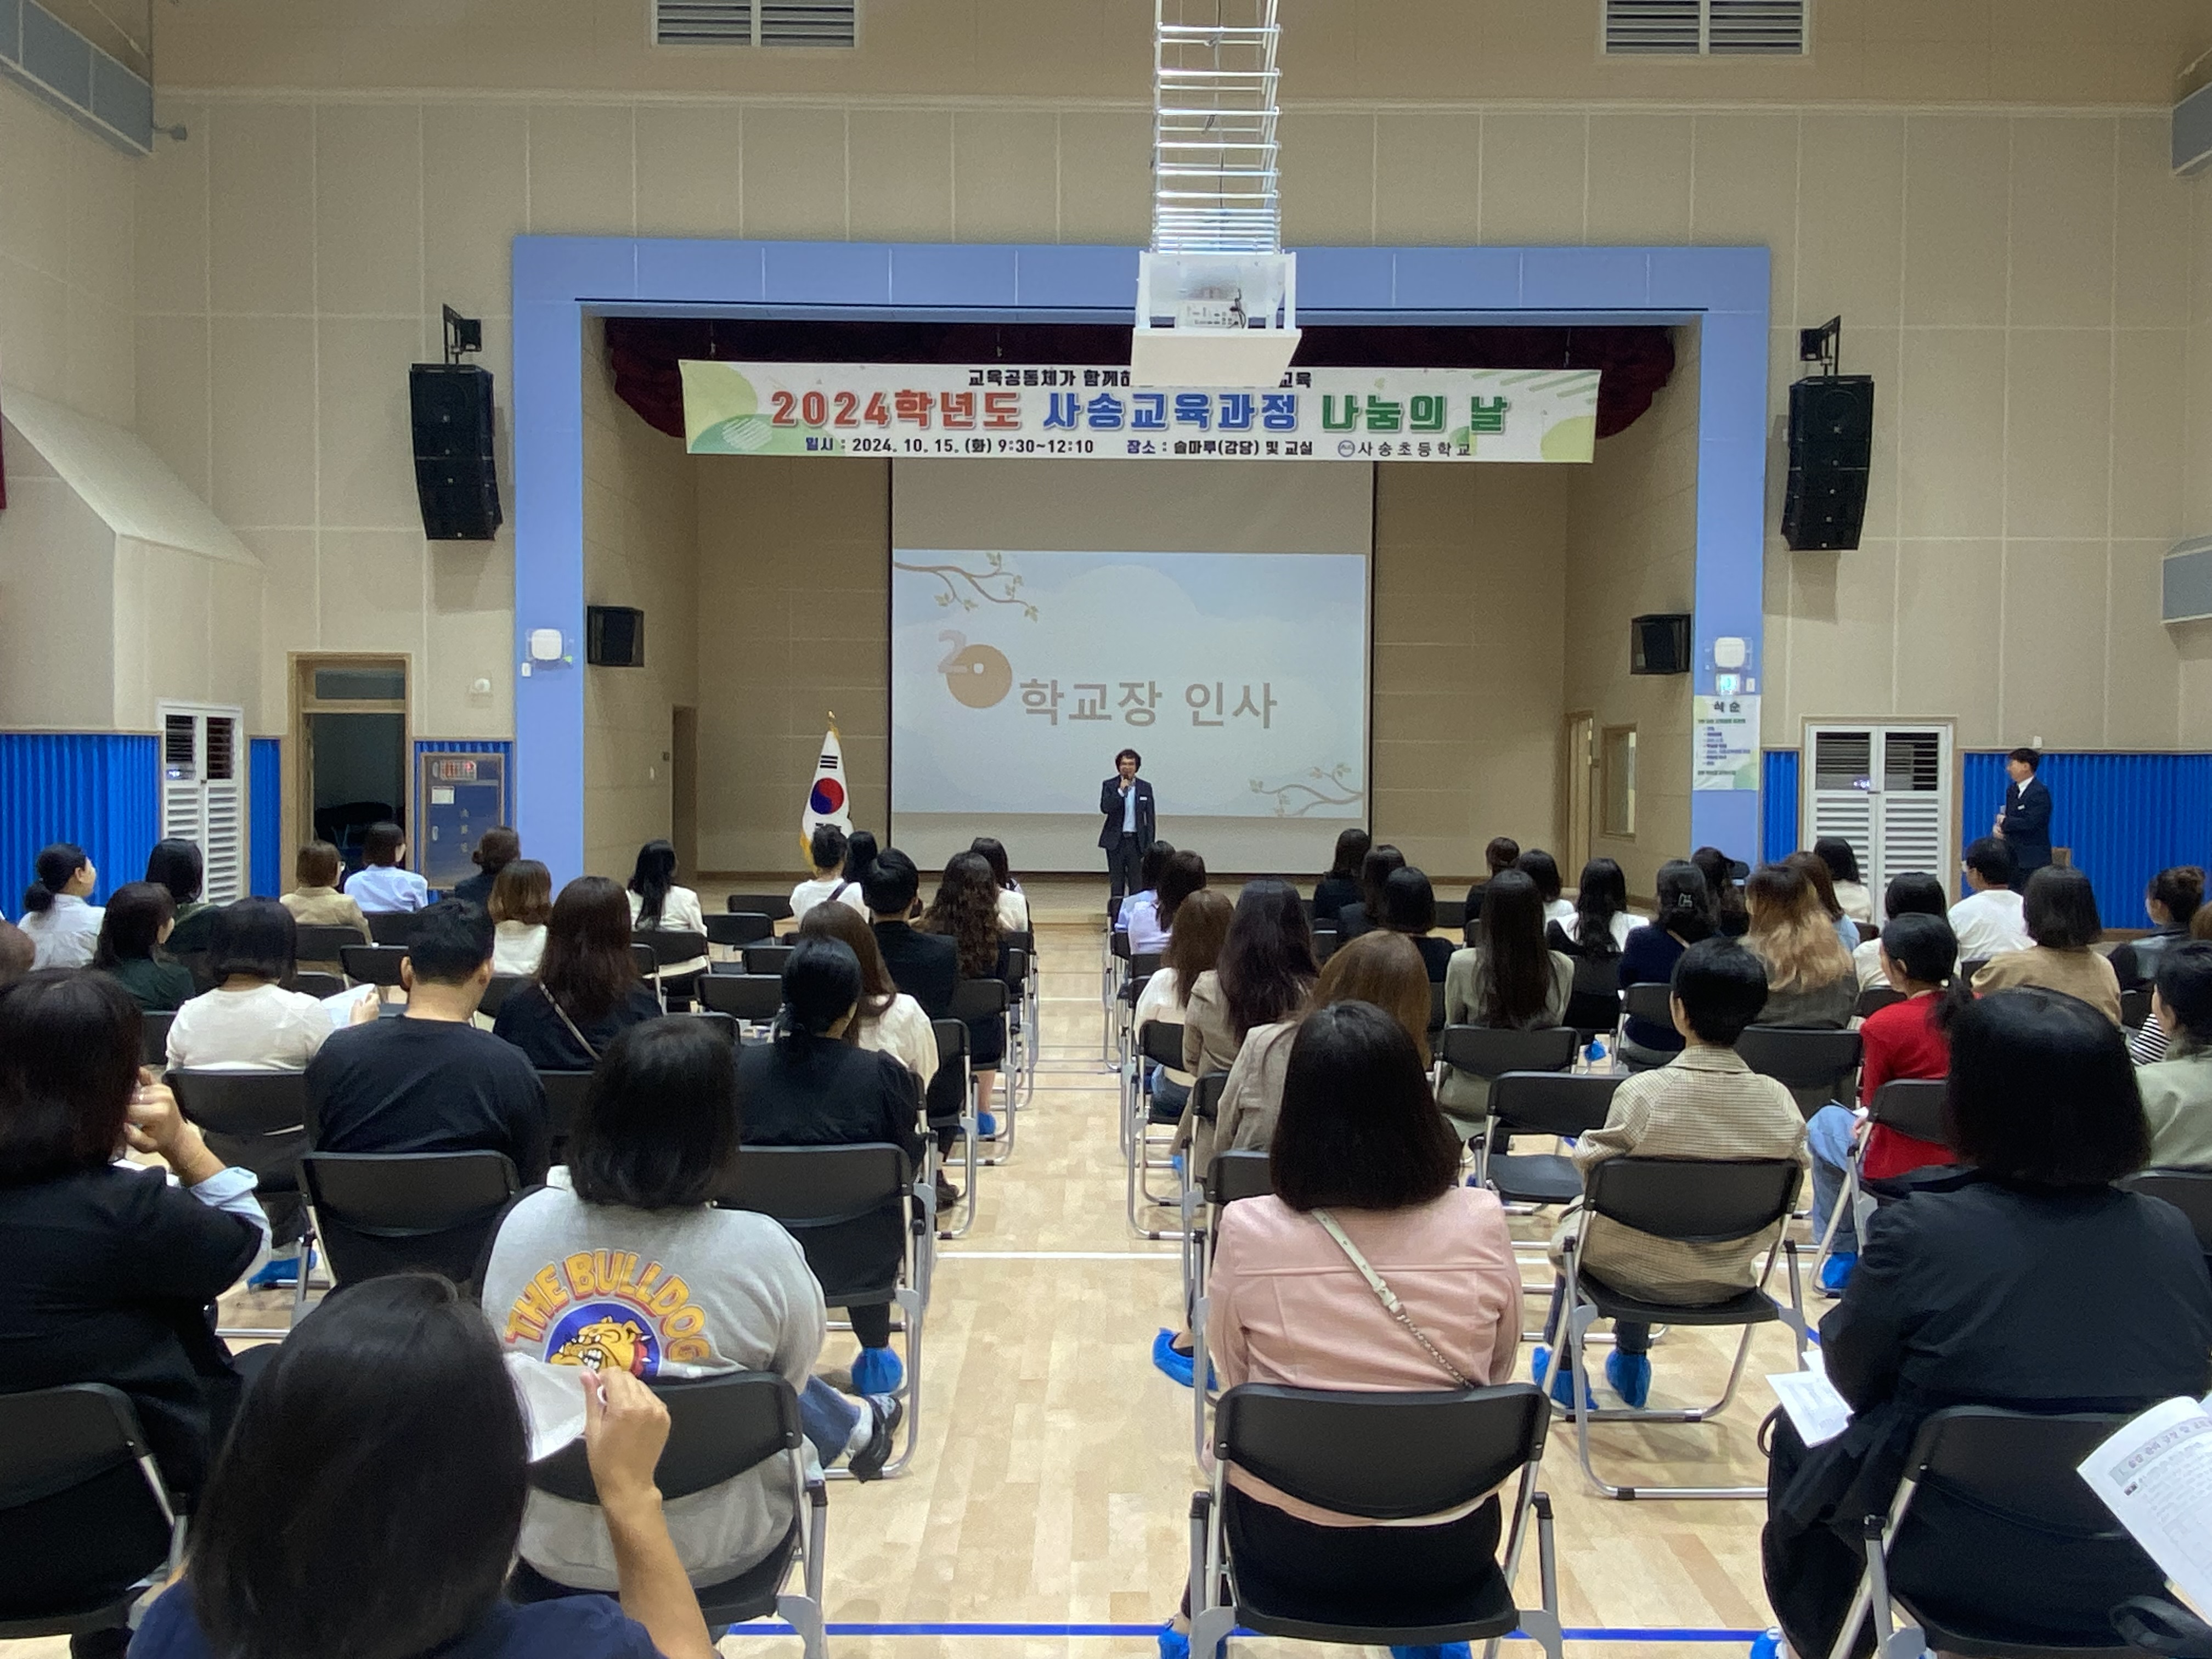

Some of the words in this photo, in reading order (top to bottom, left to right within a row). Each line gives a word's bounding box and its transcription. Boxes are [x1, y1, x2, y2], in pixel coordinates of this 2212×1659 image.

[968, 369, 1076, 386] 교육공동체가
[771, 390, 1019, 429] 2024학년도
[1043, 392, 1295, 430] 사송교육과정
[1323, 395, 1444, 431] 나눔의
[1471, 396, 1508, 432] 날
[806, 437, 833, 451] 일시
[852, 438, 898, 453] 2024.
[905, 438, 929, 453] 10.
[934, 439, 959, 454] 15.
[965, 438, 991, 454] (화)
[998, 439, 1093, 454] 9:30~12:10
[1127, 440, 1156, 454] 장소
[1266, 441, 1279, 455] 및
[1284, 441, 1313, 456] 교실
[1358, 441, 1471, 456] 사송초등학교
[1019, 678, 1163, 726] 학교장
[1185, 682, 1278, 729] 인사
[505, 1262, 569, 1344] THE
